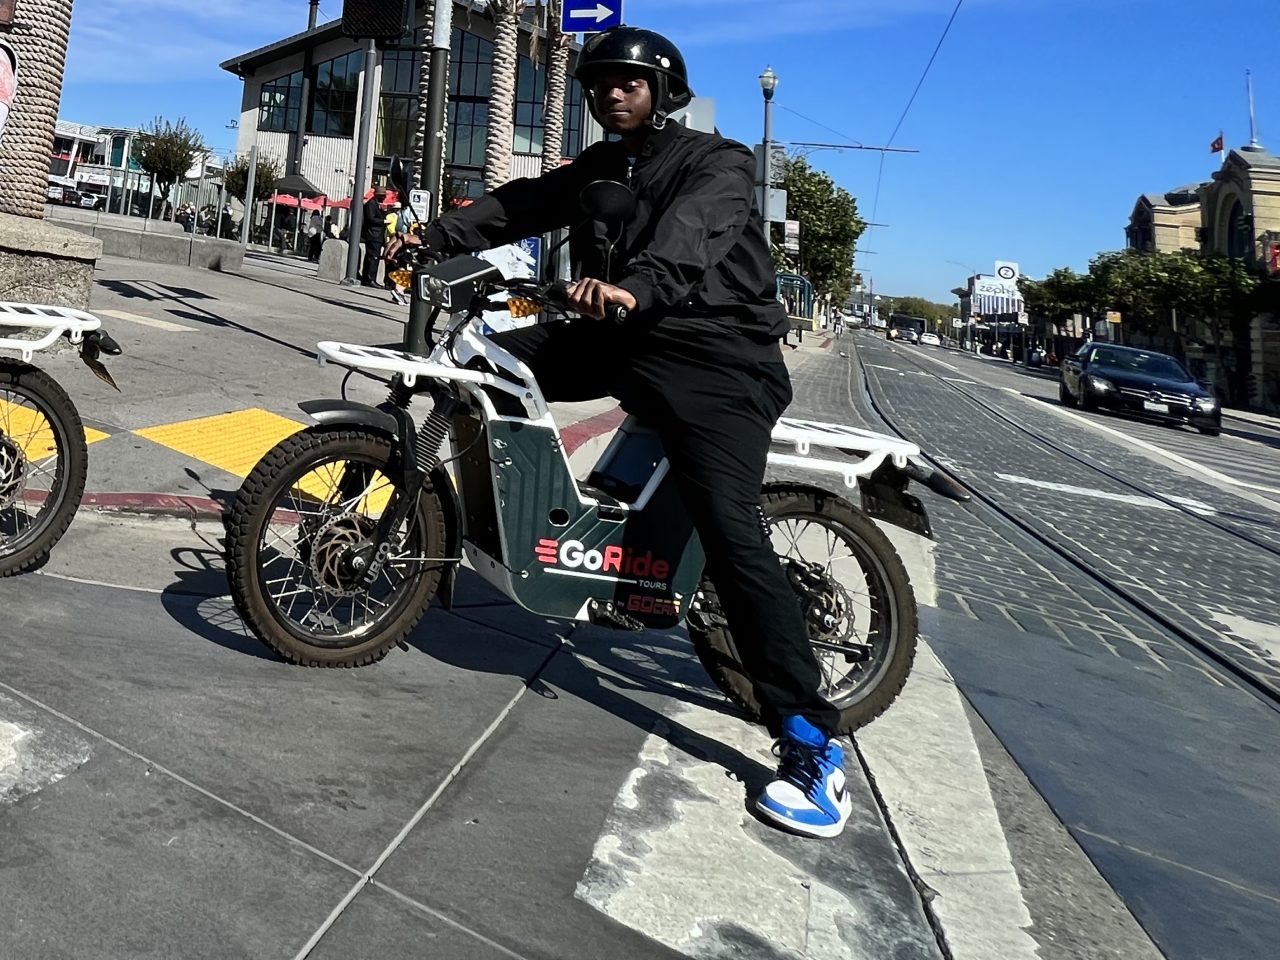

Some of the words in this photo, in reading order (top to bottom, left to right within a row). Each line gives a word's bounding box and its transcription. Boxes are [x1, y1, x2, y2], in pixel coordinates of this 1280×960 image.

[363, 542, 390, 584] UBCO
[560, 540, 670, 579] GoRide
[638, 579, 667, 591] TOURS
